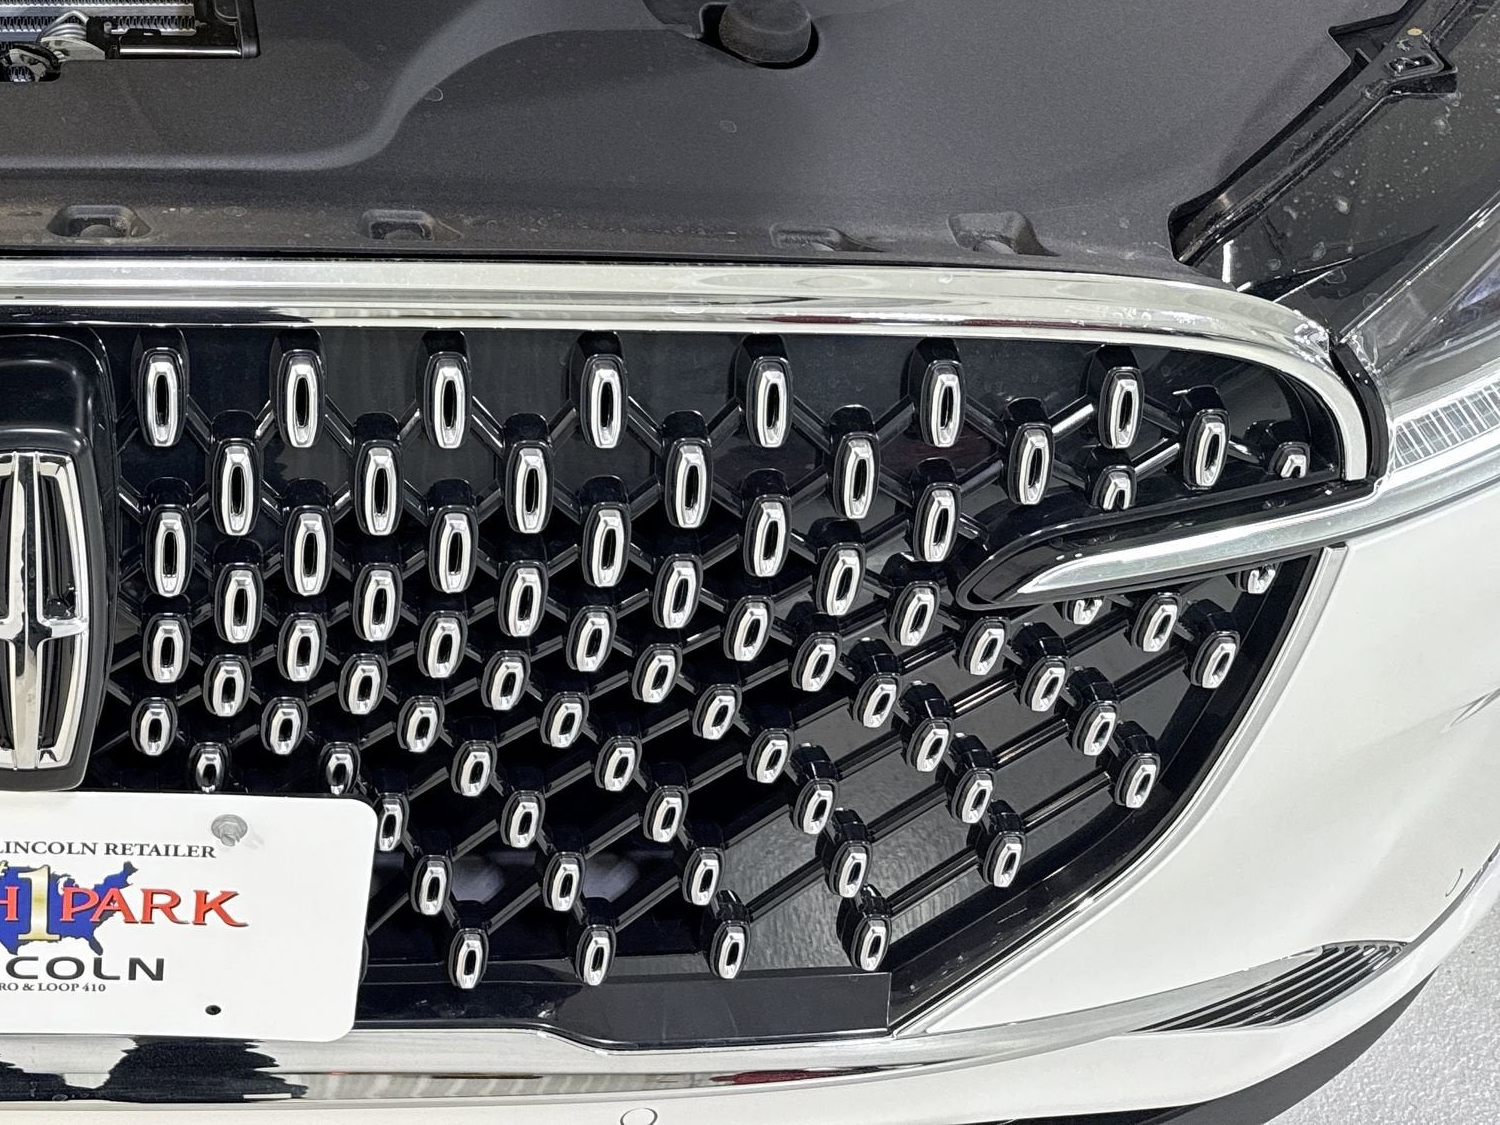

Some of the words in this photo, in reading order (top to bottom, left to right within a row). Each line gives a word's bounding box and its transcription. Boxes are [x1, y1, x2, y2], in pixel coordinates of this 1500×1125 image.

[104, 842, 217, 859] RETAILER
[60, 886, 248, 928] PARK
[22, 982, 34, 992] &
[37, 982, 80, 992] LOOP
[82, 982, 106, 992] 410
